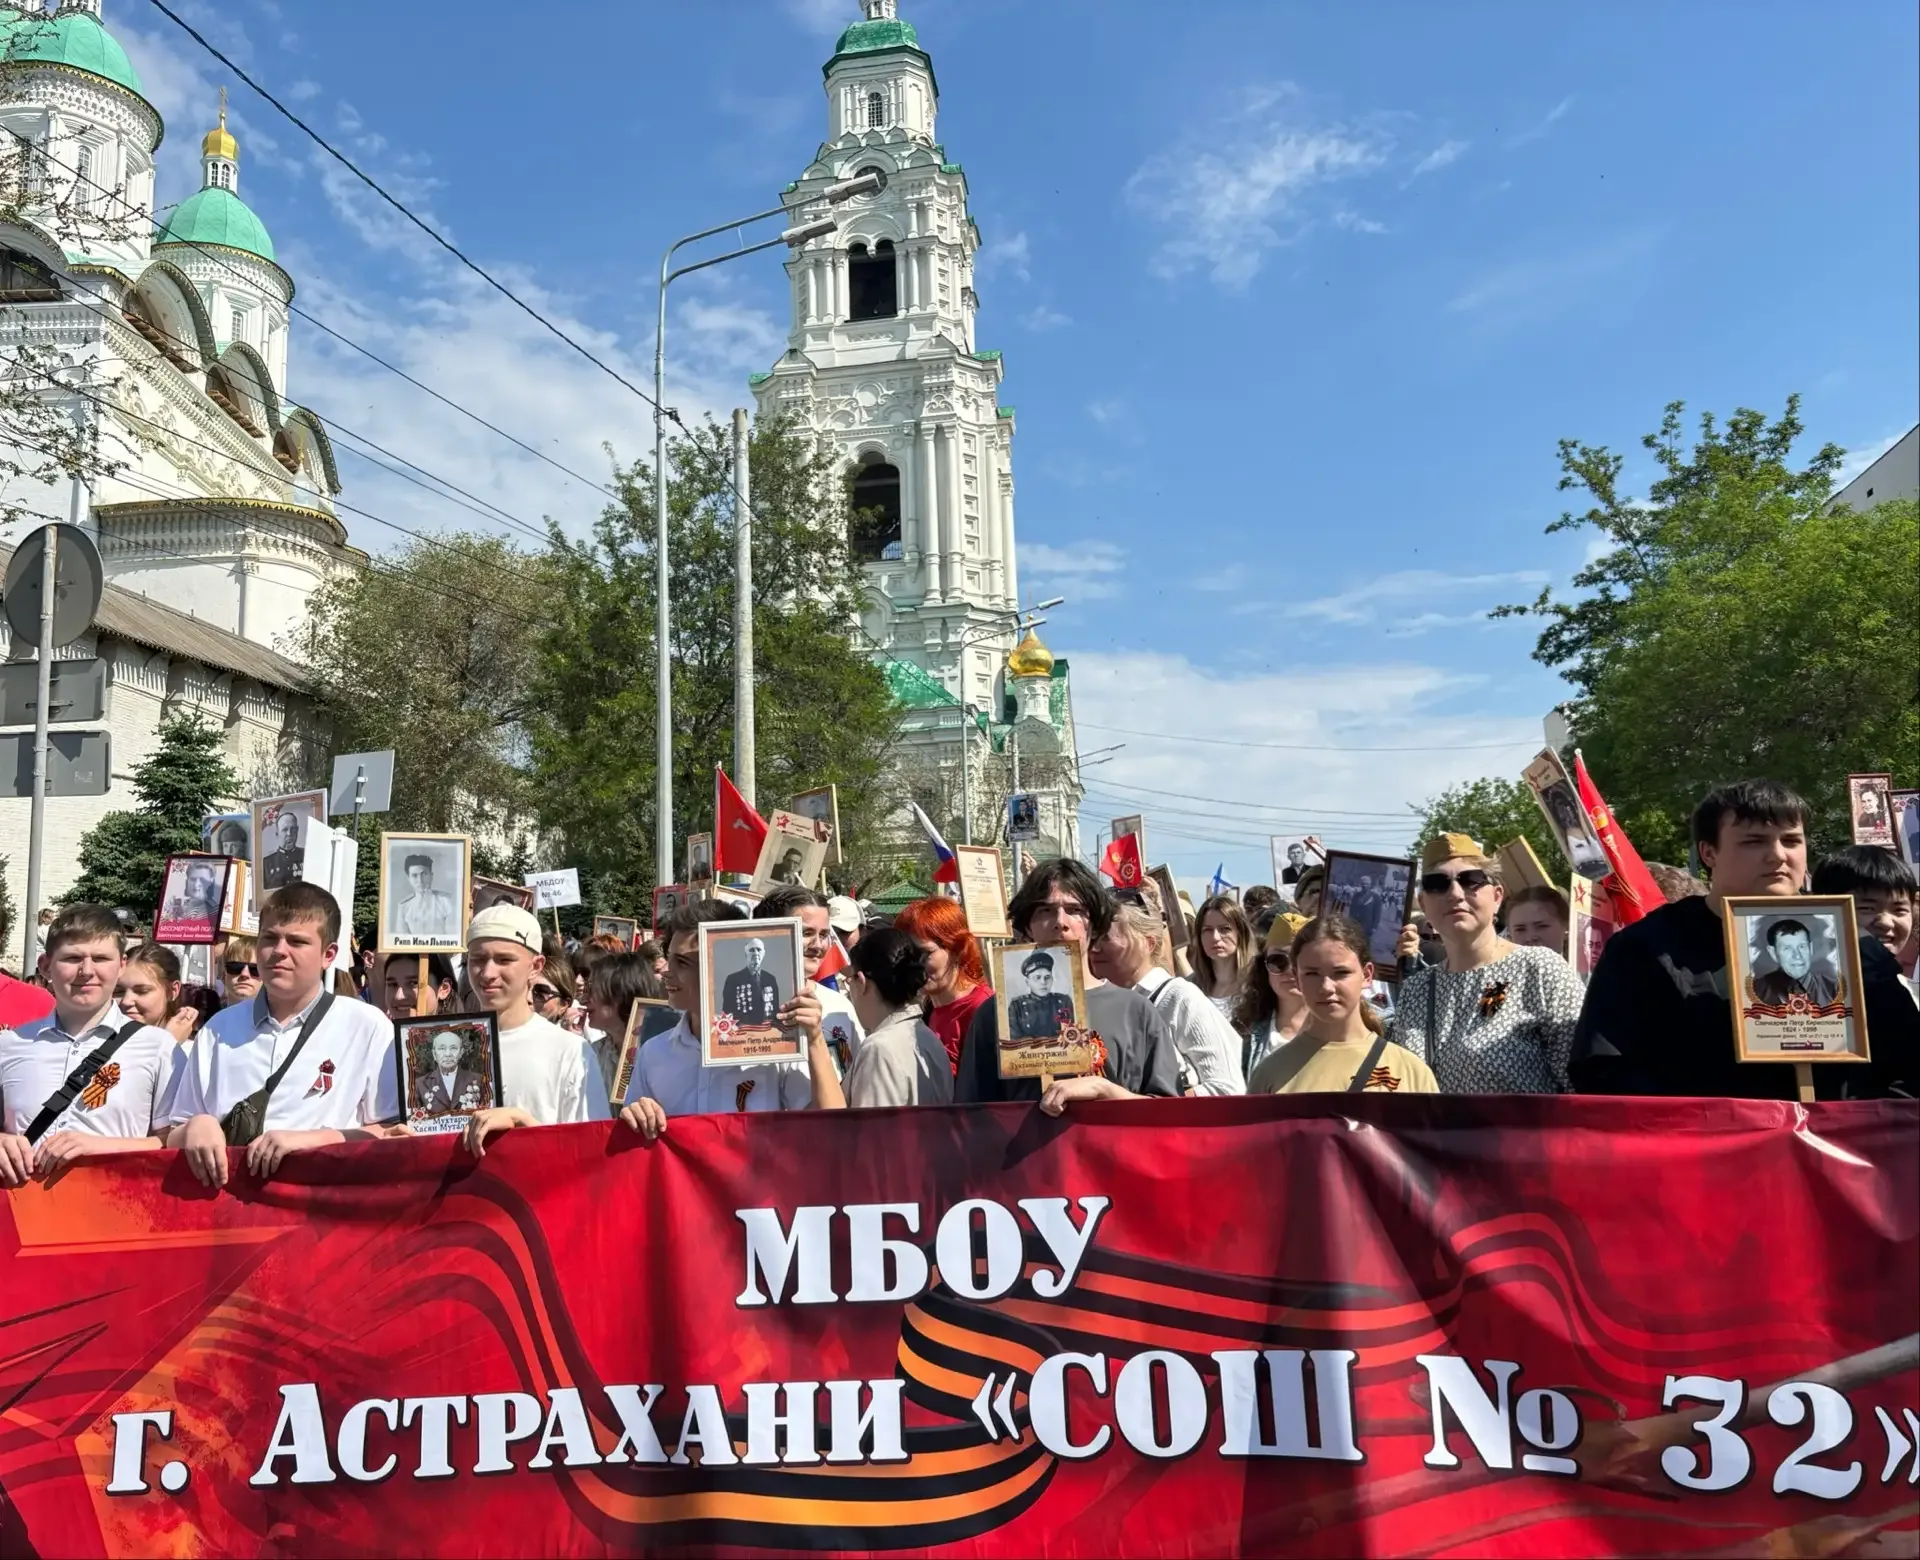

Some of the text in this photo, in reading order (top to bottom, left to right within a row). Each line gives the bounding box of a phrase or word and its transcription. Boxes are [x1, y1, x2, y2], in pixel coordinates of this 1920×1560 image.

[536, 878, 565, 887] МБДОУ
[736, 1196, 1109, 1306] МБОУ
[106, 1411, 188, 1492] г.
[971, 1349, 1363, 1461] «СОШ
[1416, 1354, 1579, 1474] №
